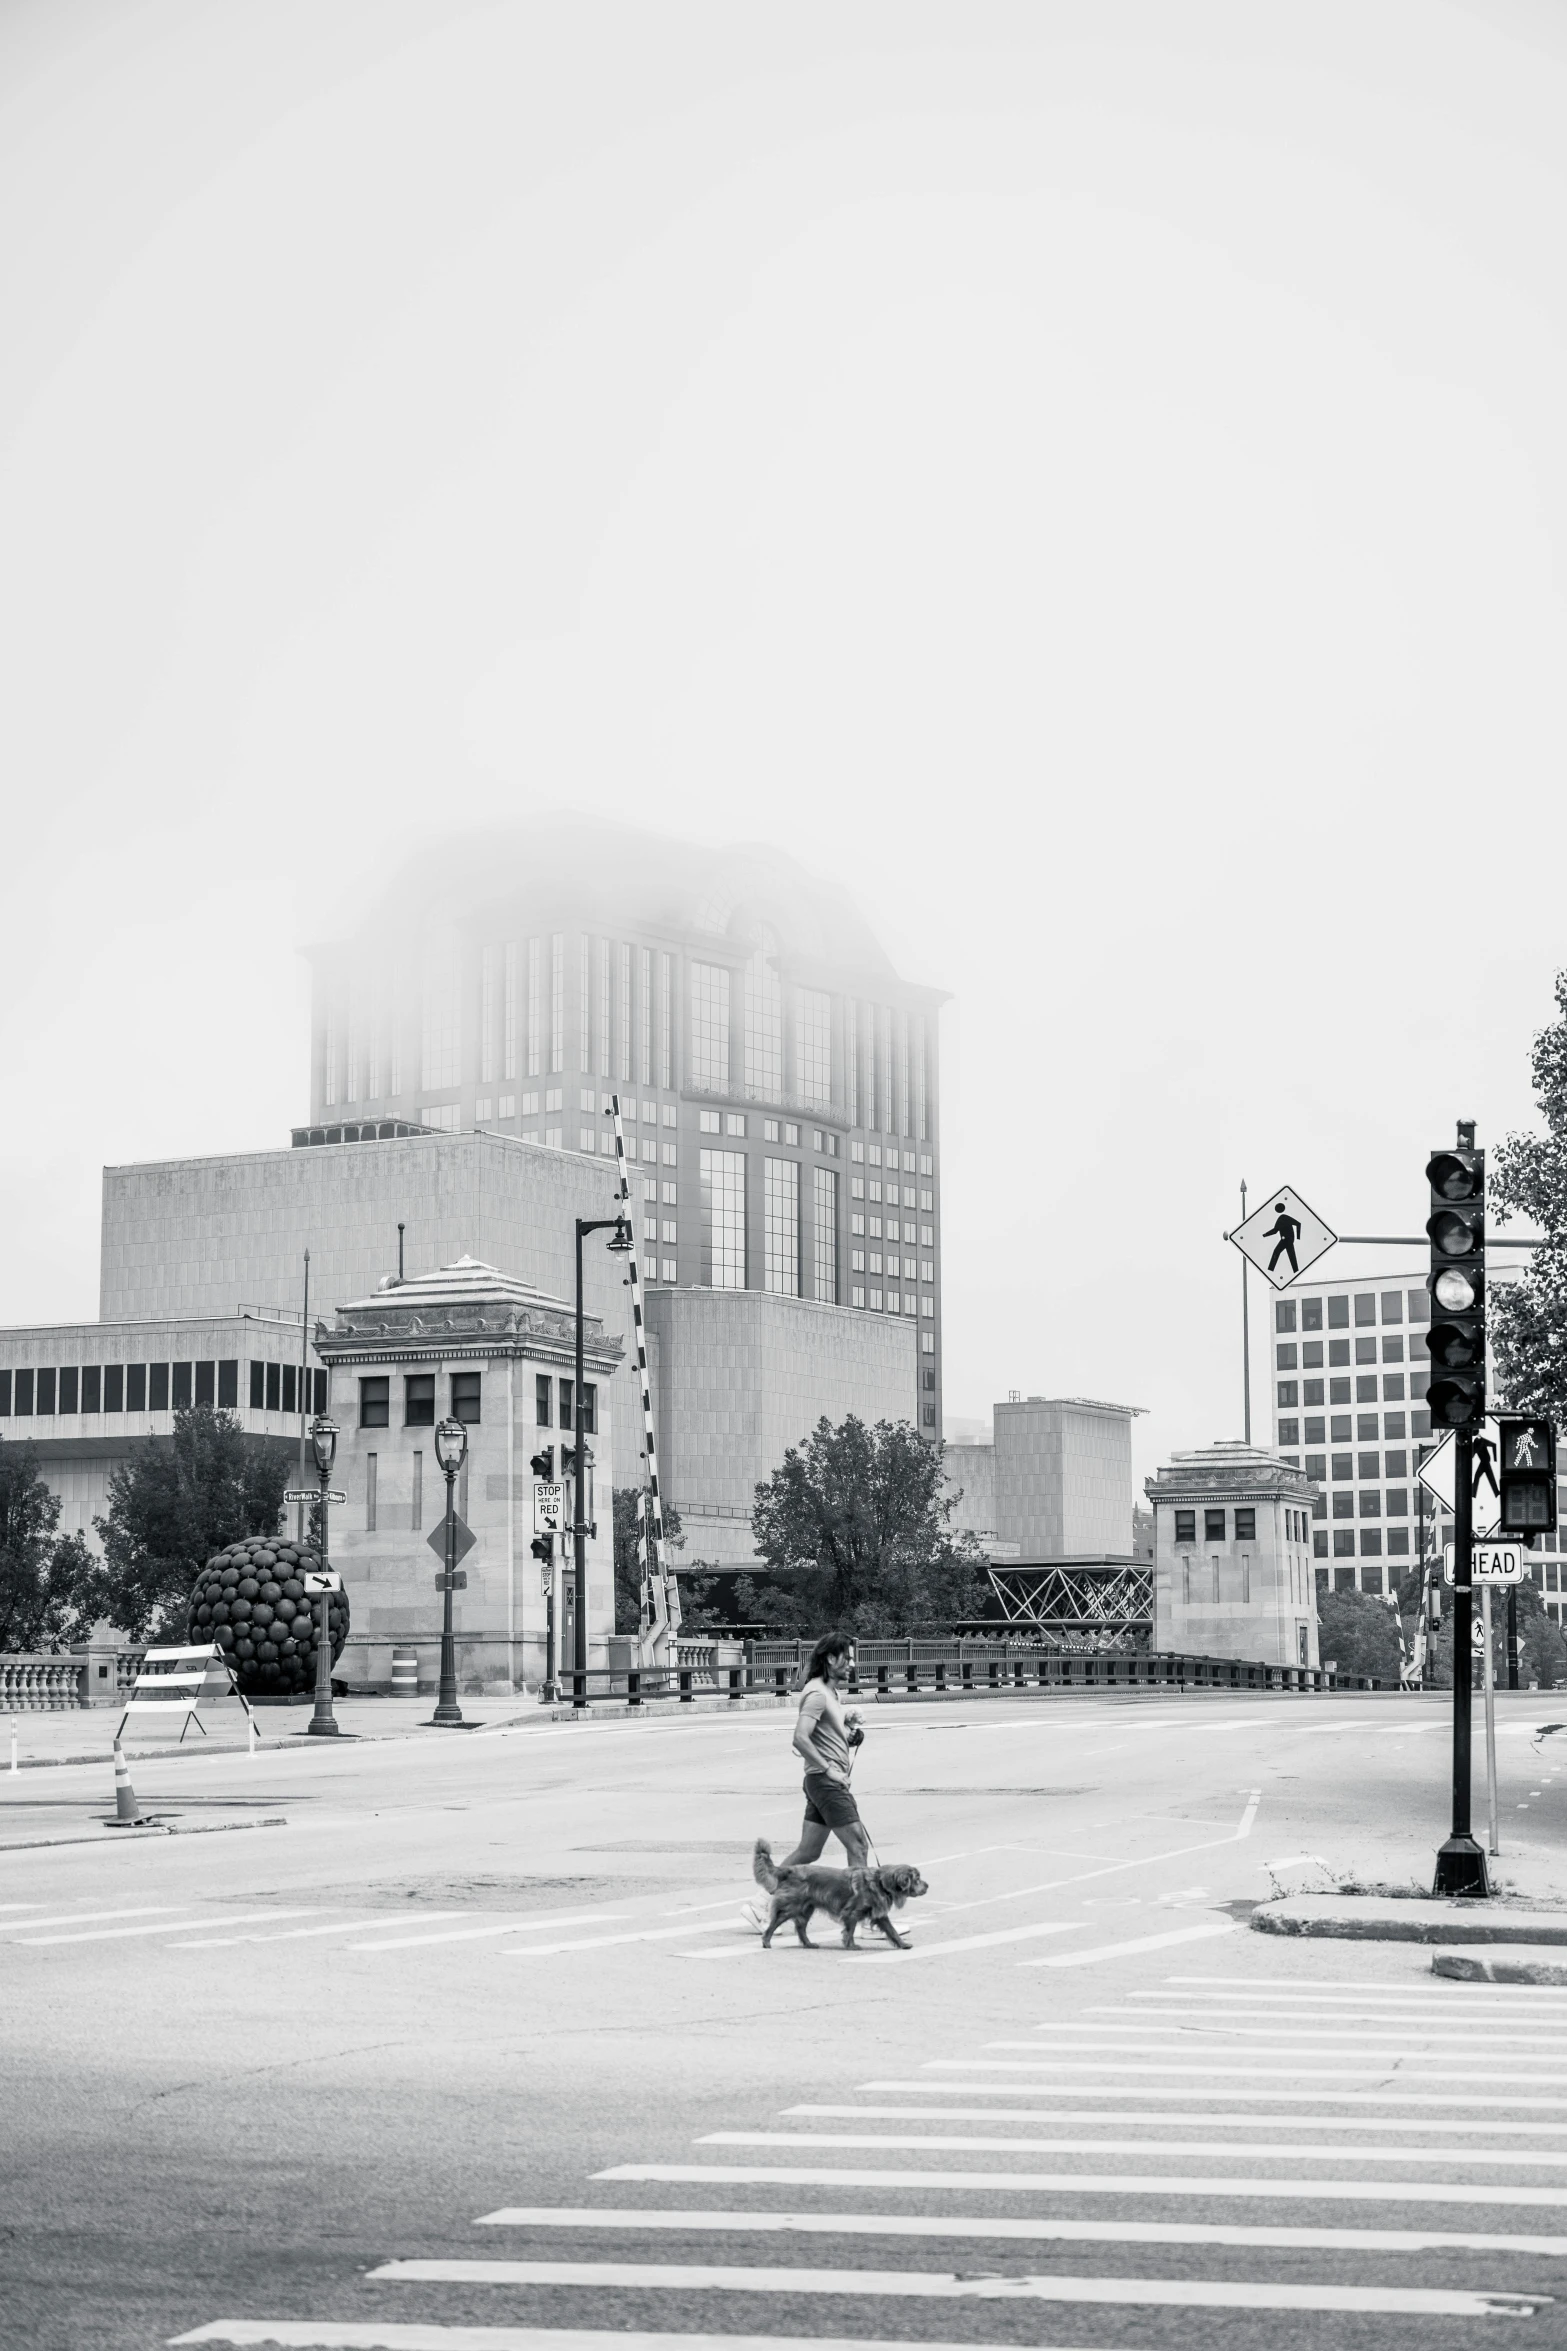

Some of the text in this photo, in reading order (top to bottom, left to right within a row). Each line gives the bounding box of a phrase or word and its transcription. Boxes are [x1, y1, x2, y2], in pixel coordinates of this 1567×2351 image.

[537, 1486, 561, 1496] STOP
[288, 1492, 313, 1501] RiverWalk
[540, 1505, 559, 1514] RED
[1452, 1553, 1515, 1574] HEAD
